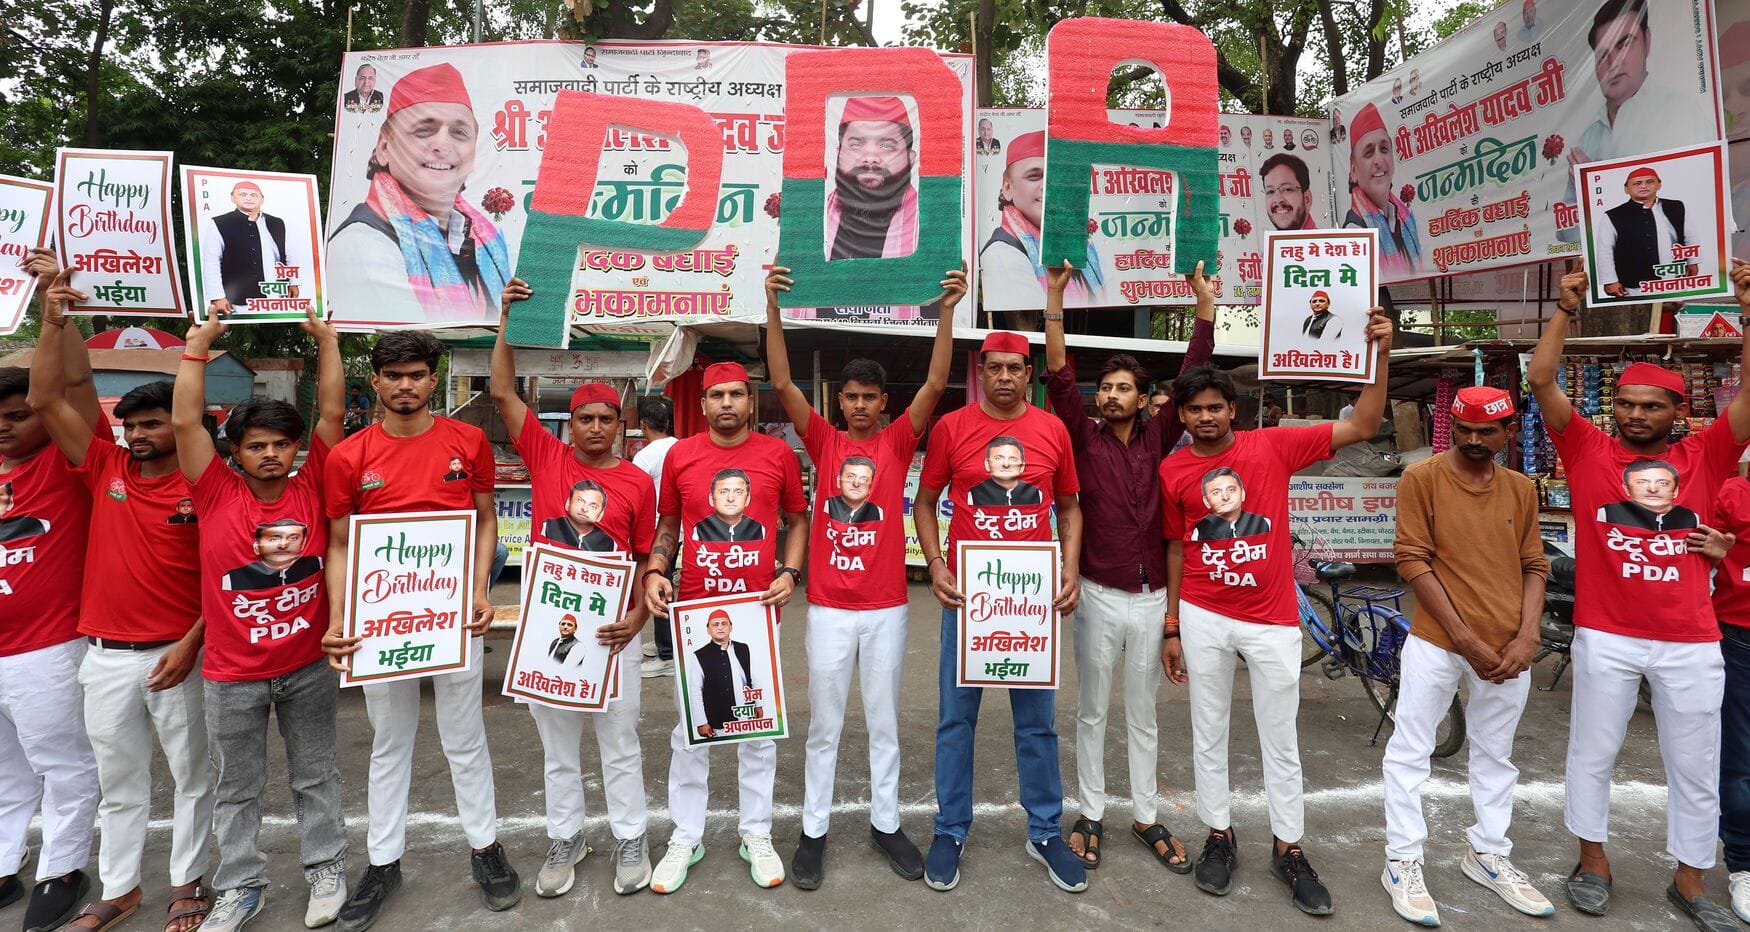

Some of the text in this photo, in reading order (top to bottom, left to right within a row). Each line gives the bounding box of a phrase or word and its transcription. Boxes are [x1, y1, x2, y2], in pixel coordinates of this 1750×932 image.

[603, 74, 641, 95] पार्टी
[644, 75, 662, 95] के
[666, 77, 722, 100] राष्ट्रीय
[727, 80, 783, 99] अध्यक्ष
[1399, 42, 1541, 119] समाजवादी पार्टी के राष्ट्रीय अध्यक्ष
[1395, 56, 1565, 161] श्री अखिलेश यादव जी
[491, 99, 532, 151] श्री
[624, 160, 638, 176] को
[1415, 134, 1538, 203] जन्मदिन
[77, 168, 151, 209] Happy
[1227, 167, 1252, 198] जी
[68, 204, 157, 244] Birthday
[1429, 190, 1531, 238] हार्दिक बधाई
[73, 249, 162, 274] अखिलेश
[1280, 245, 1304, 262] लहु
[1308, 242, 1320, 257] मे
[1324, 242, 1347, 257] देश
[1433, 224, 1531, 273] शुभकामनाएं
[1671, 243, 1700, 260] प्रेम
[274, 261, 300, 278] प्रेम
[1283, 263, 1358, 288] दिल मे
[1654, 262, 1687, 277] दया
[94, 280, 146, 306] भईया
[259, 281, 288, 295] दया
[1639, 275, 1713, 294] अपनापन
[246, 297, 312, 312] अपनापन
[1272, 349, 1337, 369] अखिलेश
[1483, 399, 1508, 415] छात्र
[842, 526, 877, 547] टीम
[973, 509, 1003, 539] टैटू
[1003, 509, 1038, 531] टीम
[375, 532, 455, 568] Happy
[1201, 540, 1267, 573] टैटू टीम
[1607, 527, 1688, 562] टैटू टीम
[543, 561, 564, 582] लहु
[566, 564, 577, 580] मे
[581, 568, 602, 585] देश
[696, 544, 760, 576] टैटू टीम
[1622, 562, 1680, 582] PDA
[362, 569, 459, 604] Birthday
[704, 578, 746, 593] PDA
[977, 559, 1043, 595] Happy
[232, 582, 319, 625] टैटू टीम
[540, 581, 608, 616] दिल मे
[970, 592, 1049, 625] Birthday
[250, 615, 310, 644] PDA
[361, 608, 458, 638] अखिलेश
[971, 630, 1048, 652] अखिलेश
[379, 641, 434, 669] भईया
[985, 658, 1029, 680] भईया
[517, 671, 576, 697] अखिलेश
[743, 686, 763, 702] प्रेम
[731, 705, 755, 718] दया
[723, 717, 774, 734] अपनापन
